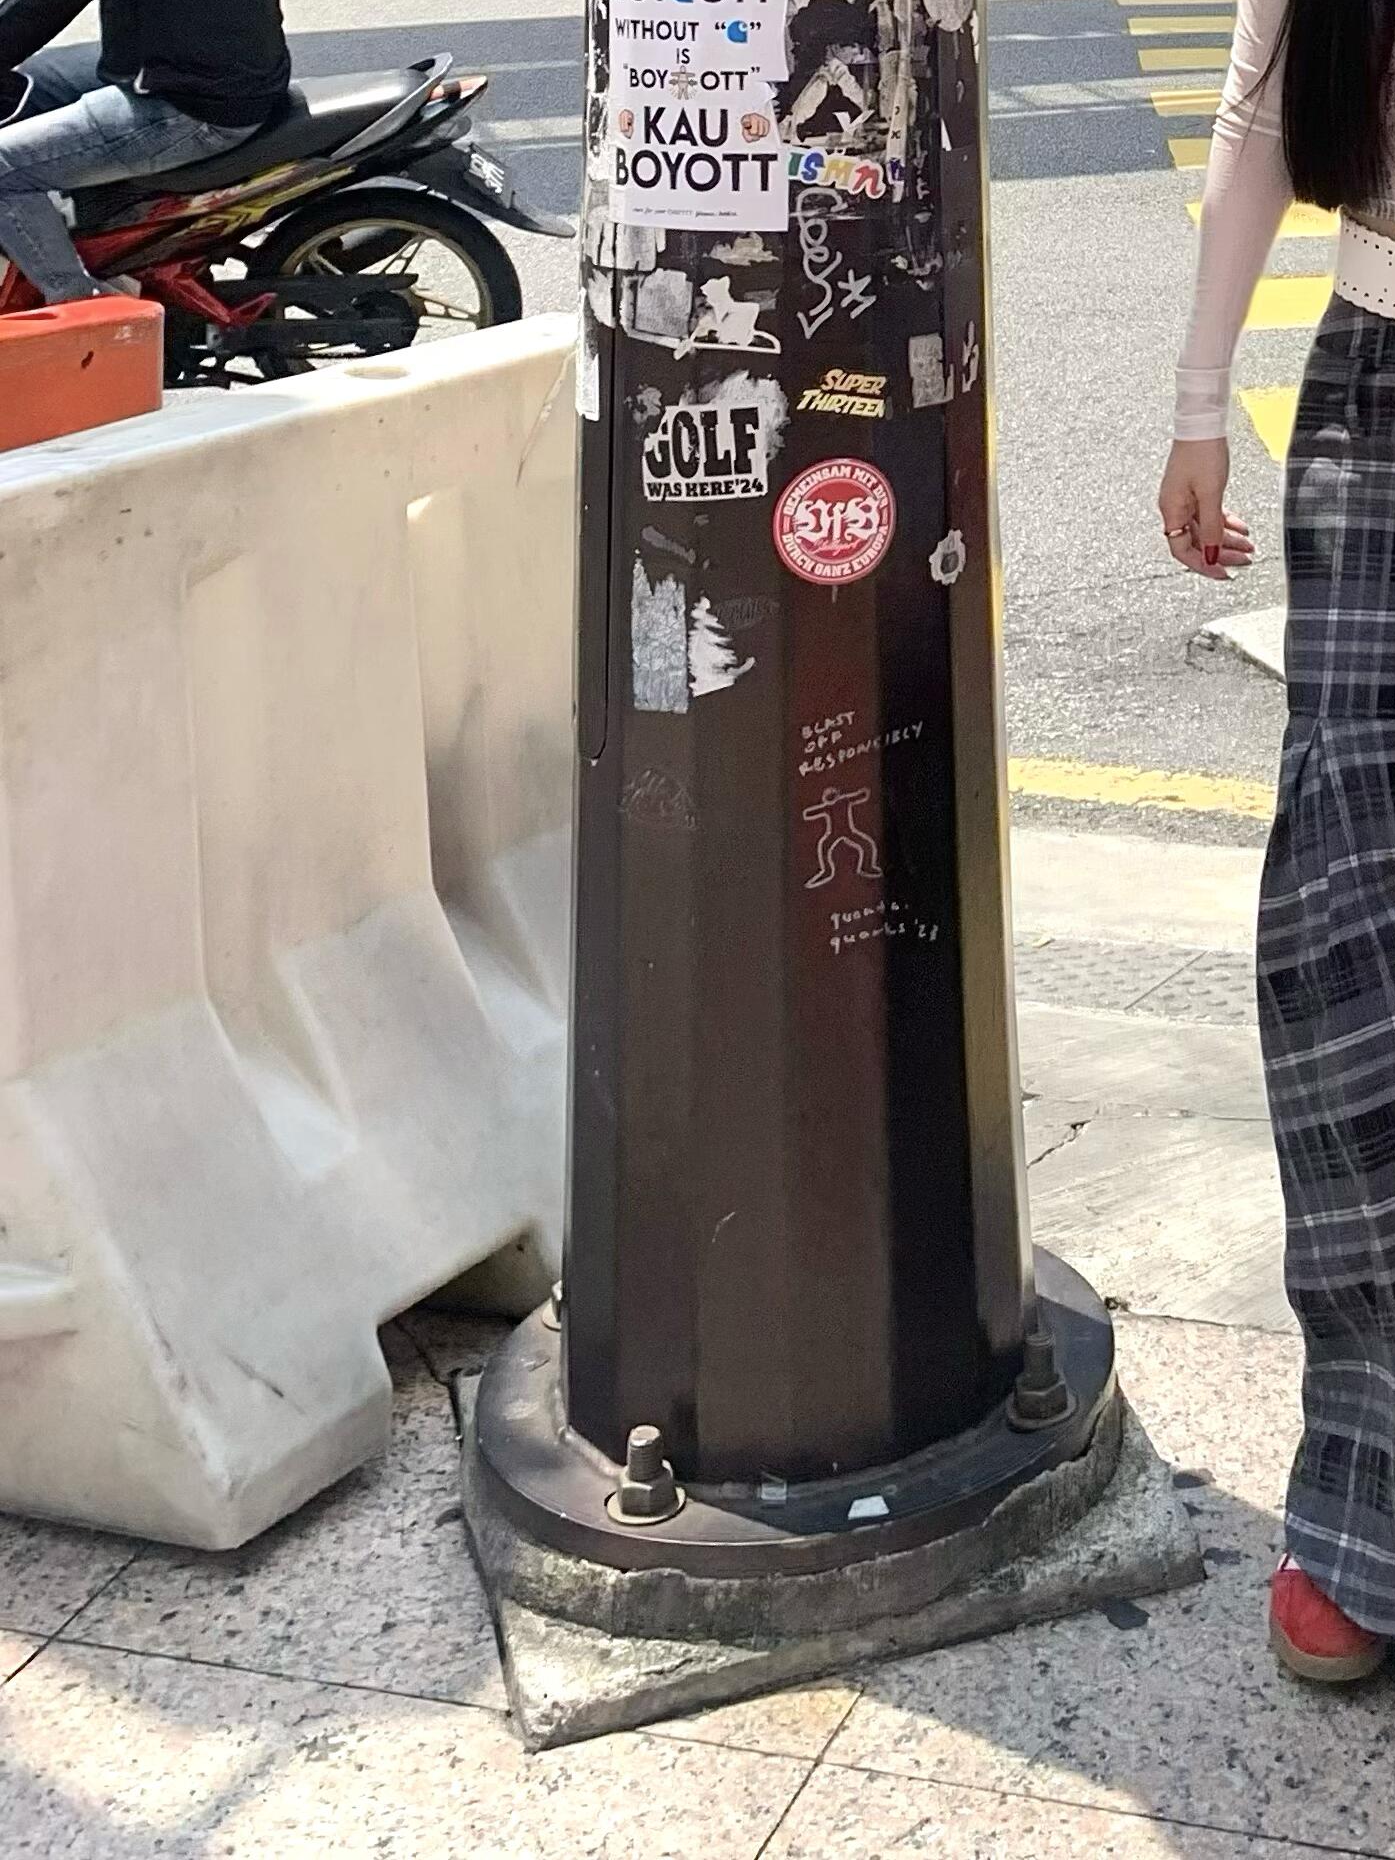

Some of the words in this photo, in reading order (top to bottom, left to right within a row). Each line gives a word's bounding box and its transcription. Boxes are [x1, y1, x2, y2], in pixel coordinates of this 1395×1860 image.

[615, 19, 700, 42] WITHOUT
[676, 47, 691, 65] IS
[643, 105, 729, 147] KAU
[615, 149, 778, 192] BOYOTT
[821, 368, 887, 396] SUPER
[796, 389, 886, 418] THIRTEEN
[645, 406, 760, 480] GOLF
[646, 482, 682, 498] WAS
[782, 464, 852, 516] GEMEINSAM
[852, 467, 875, 488] MIT
[781, 531, 816, 572] DURCH
[850, 524, 889, 572] EUROPA
[801, 710, 856, 740] BLAST
